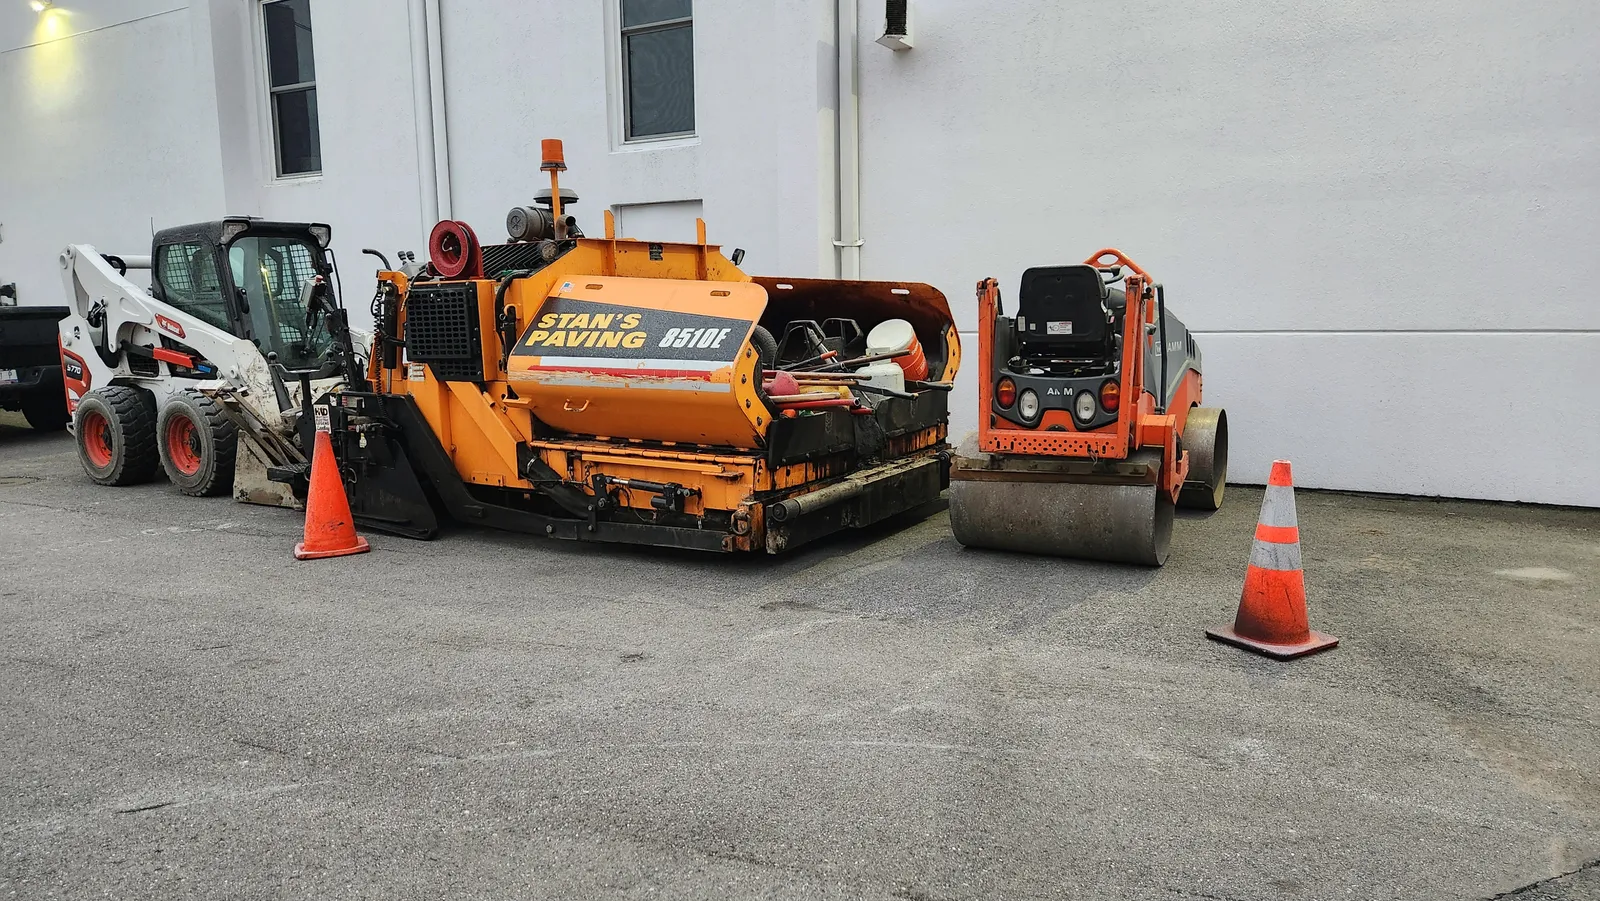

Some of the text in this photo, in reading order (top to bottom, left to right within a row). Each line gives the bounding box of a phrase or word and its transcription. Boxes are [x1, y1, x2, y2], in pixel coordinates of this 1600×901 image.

[538, 313, 642, 329] STAN'S
[524, 330, 647, 349] PAVING
[658, 327, 732, 349] 8510E
[66, 364, 82, 375] S770
